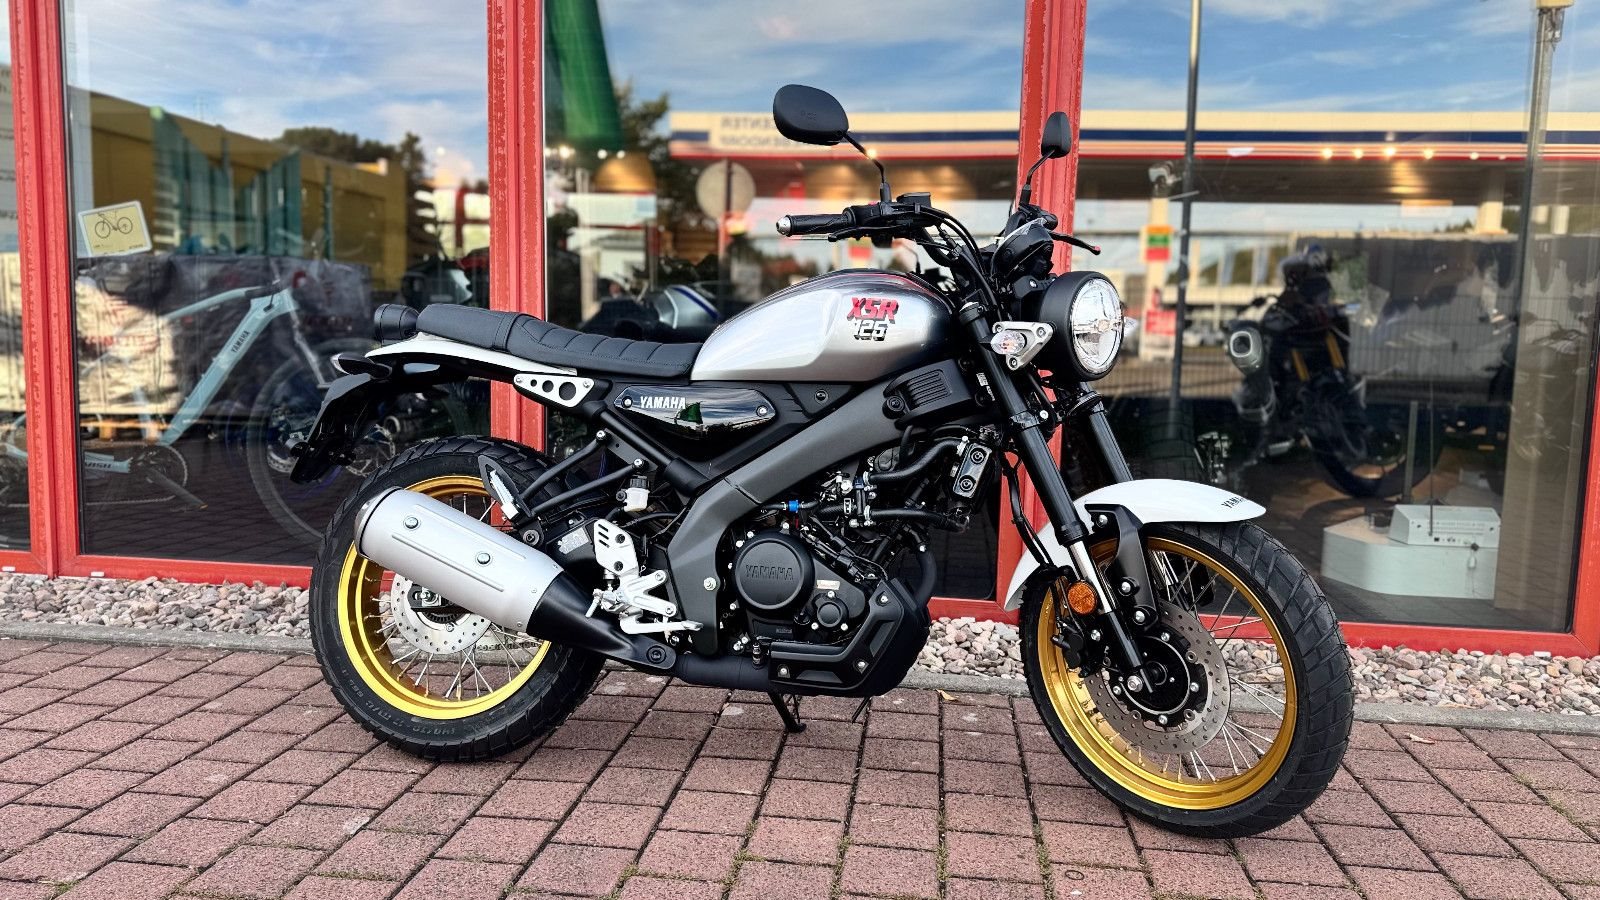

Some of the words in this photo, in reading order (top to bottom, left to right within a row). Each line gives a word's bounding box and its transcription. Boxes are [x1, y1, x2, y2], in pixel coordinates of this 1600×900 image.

[847, 297, 899, 324] XSR
[853, 319, 888, 341] 125
[231, 330, 250, 353] YAMAHA
[640, 396, 686, 409] YAMAHA
[745, 565, 794, 581] YAMAHA
